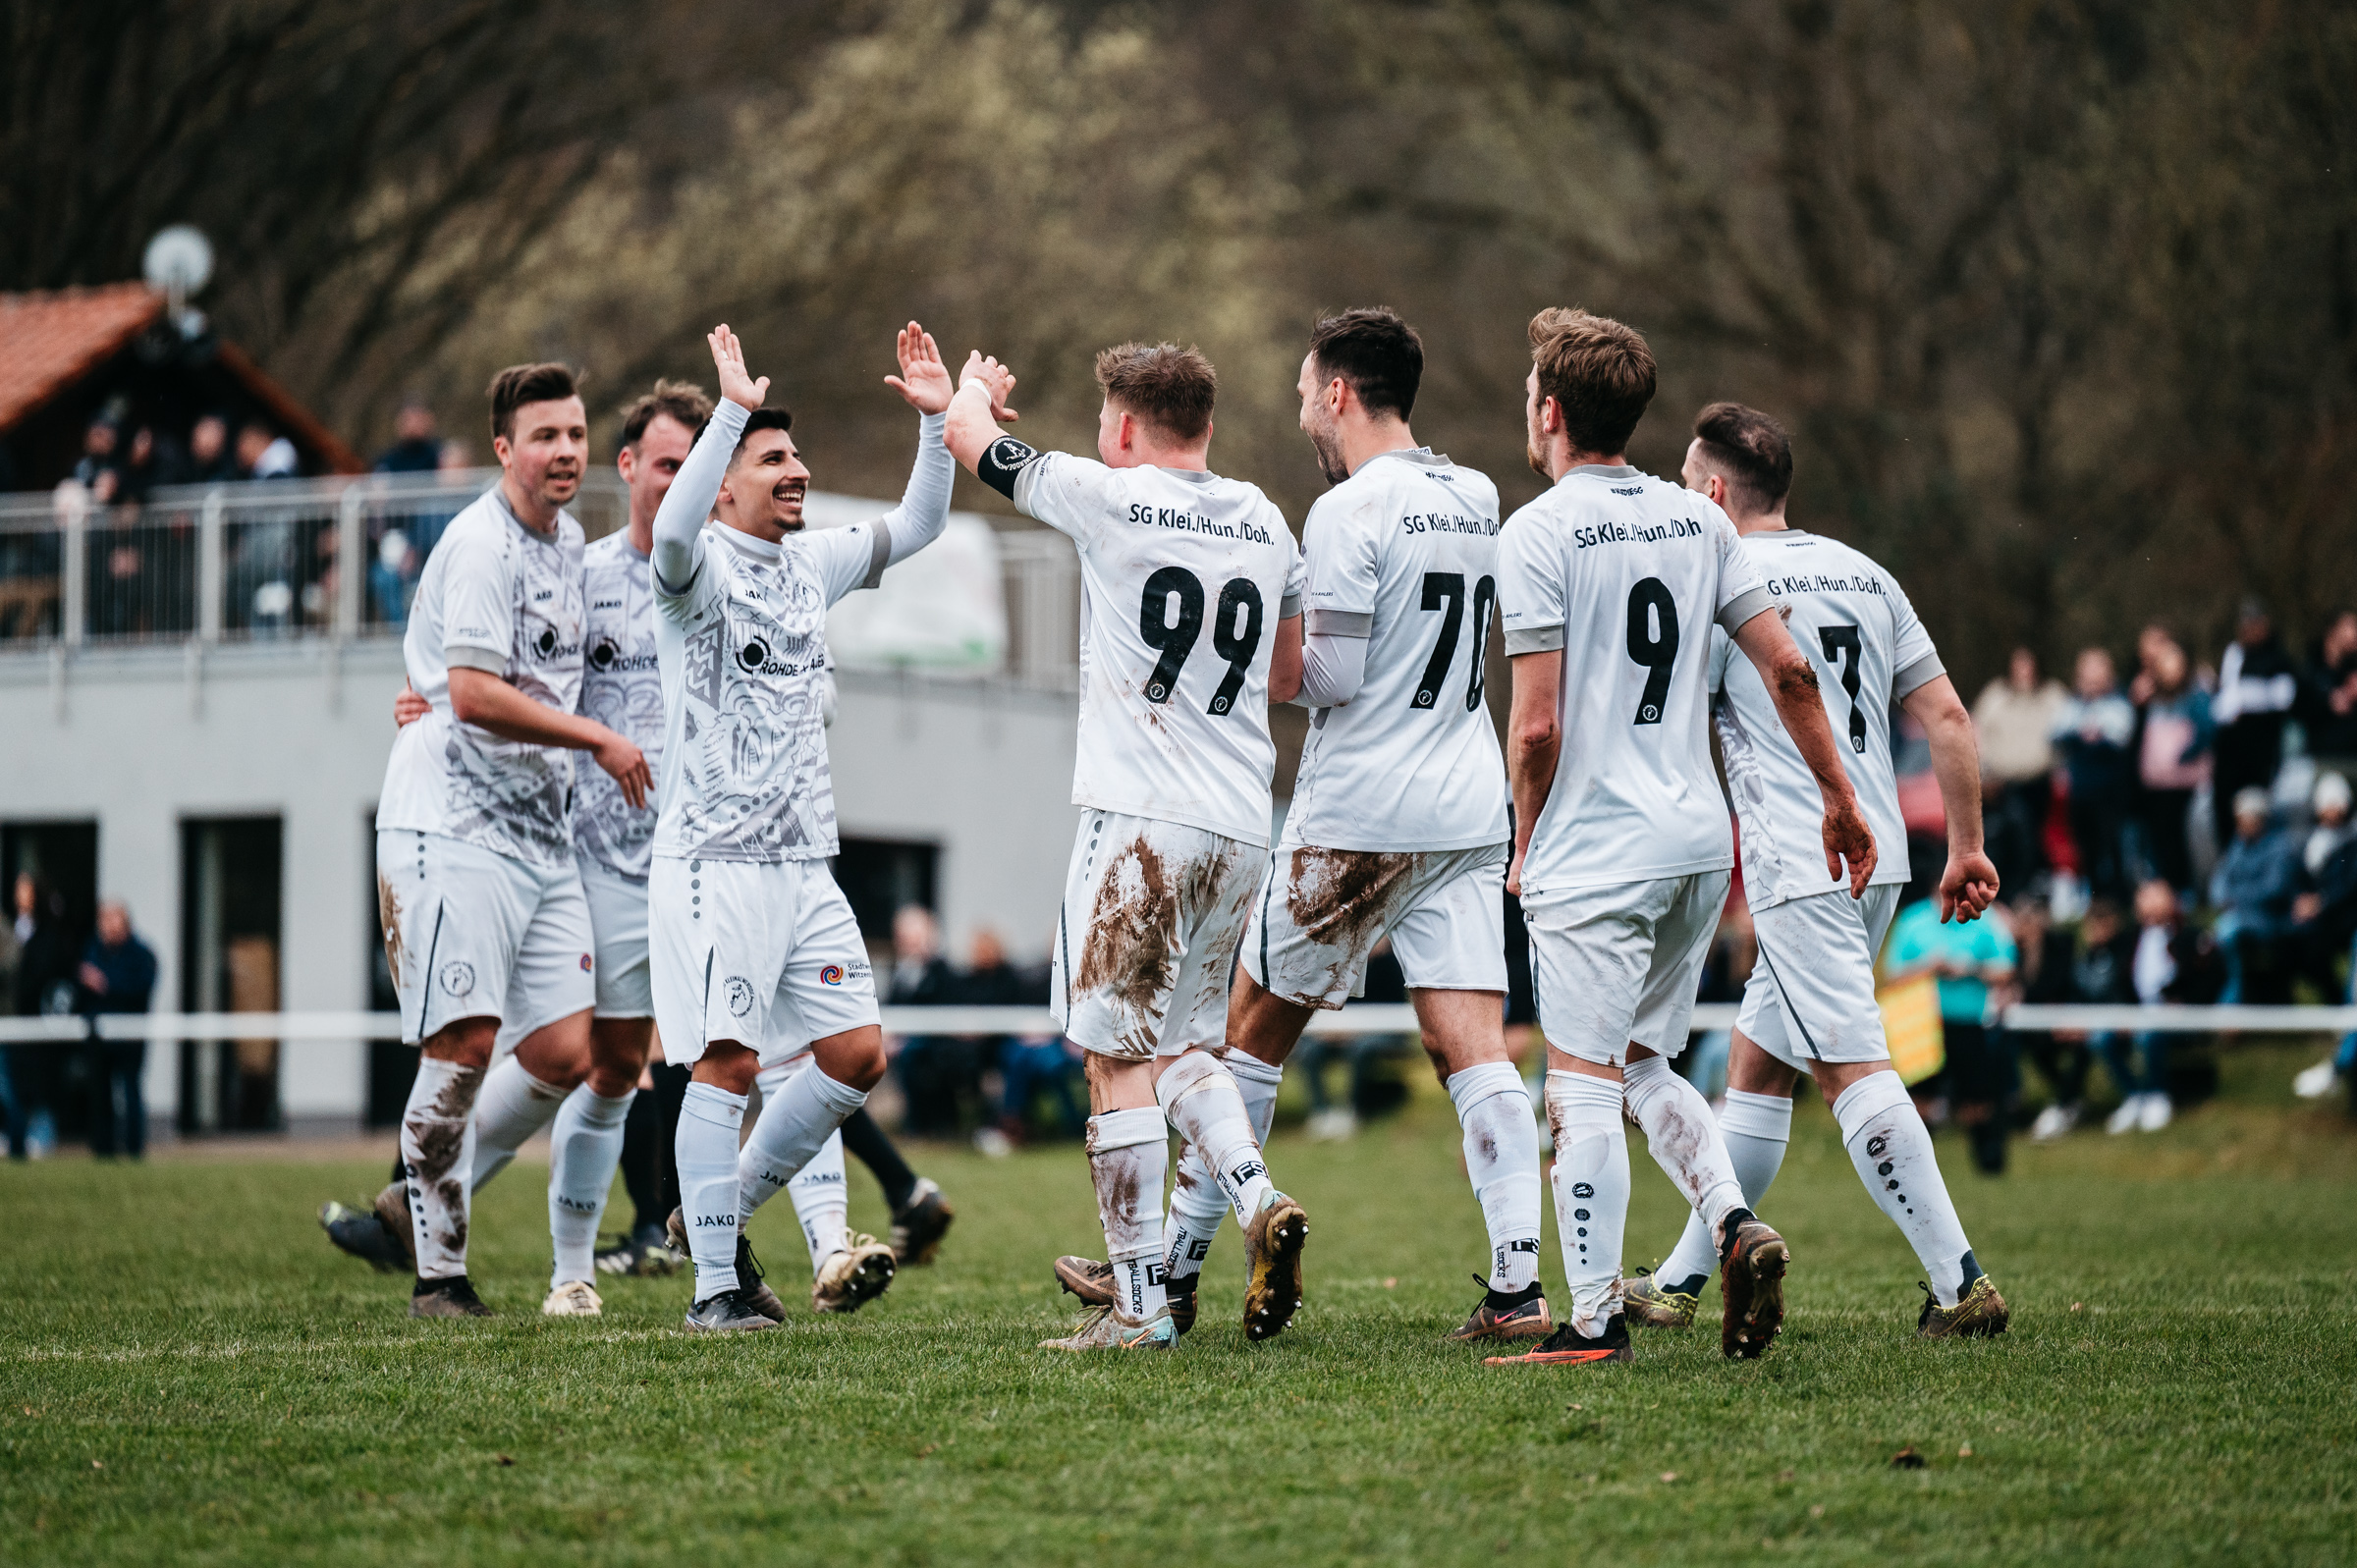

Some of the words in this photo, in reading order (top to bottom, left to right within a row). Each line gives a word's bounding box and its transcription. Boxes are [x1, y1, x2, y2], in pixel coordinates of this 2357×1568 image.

[1128, 504, 1152, 524] SG
[1158, 508, 1275, 545] Klei./Hun./Doh.
[1403, 515, 1425, 534] SG
[1427, 513, 1499, 536] Klei./Hun./Do
[1574, 527, 1597, 549] SG
[1767, 579, 1782, 596] G
[1782, 574, 1887, 596] Klei./Hun./Doh.
[593, 601, 622, 610] JAKO
[1139, 566, 1264, 716] 99
[1409, 572, 1496, 712] 70
[1626, 576, 1680, 726] 9
[759, 661, 798, 676] ROHDE
[1818, 624, 1867, 754] 7
[557, 1194, 596, 1212] JAKO
[695, 1214, 736, 1227] JAKO
